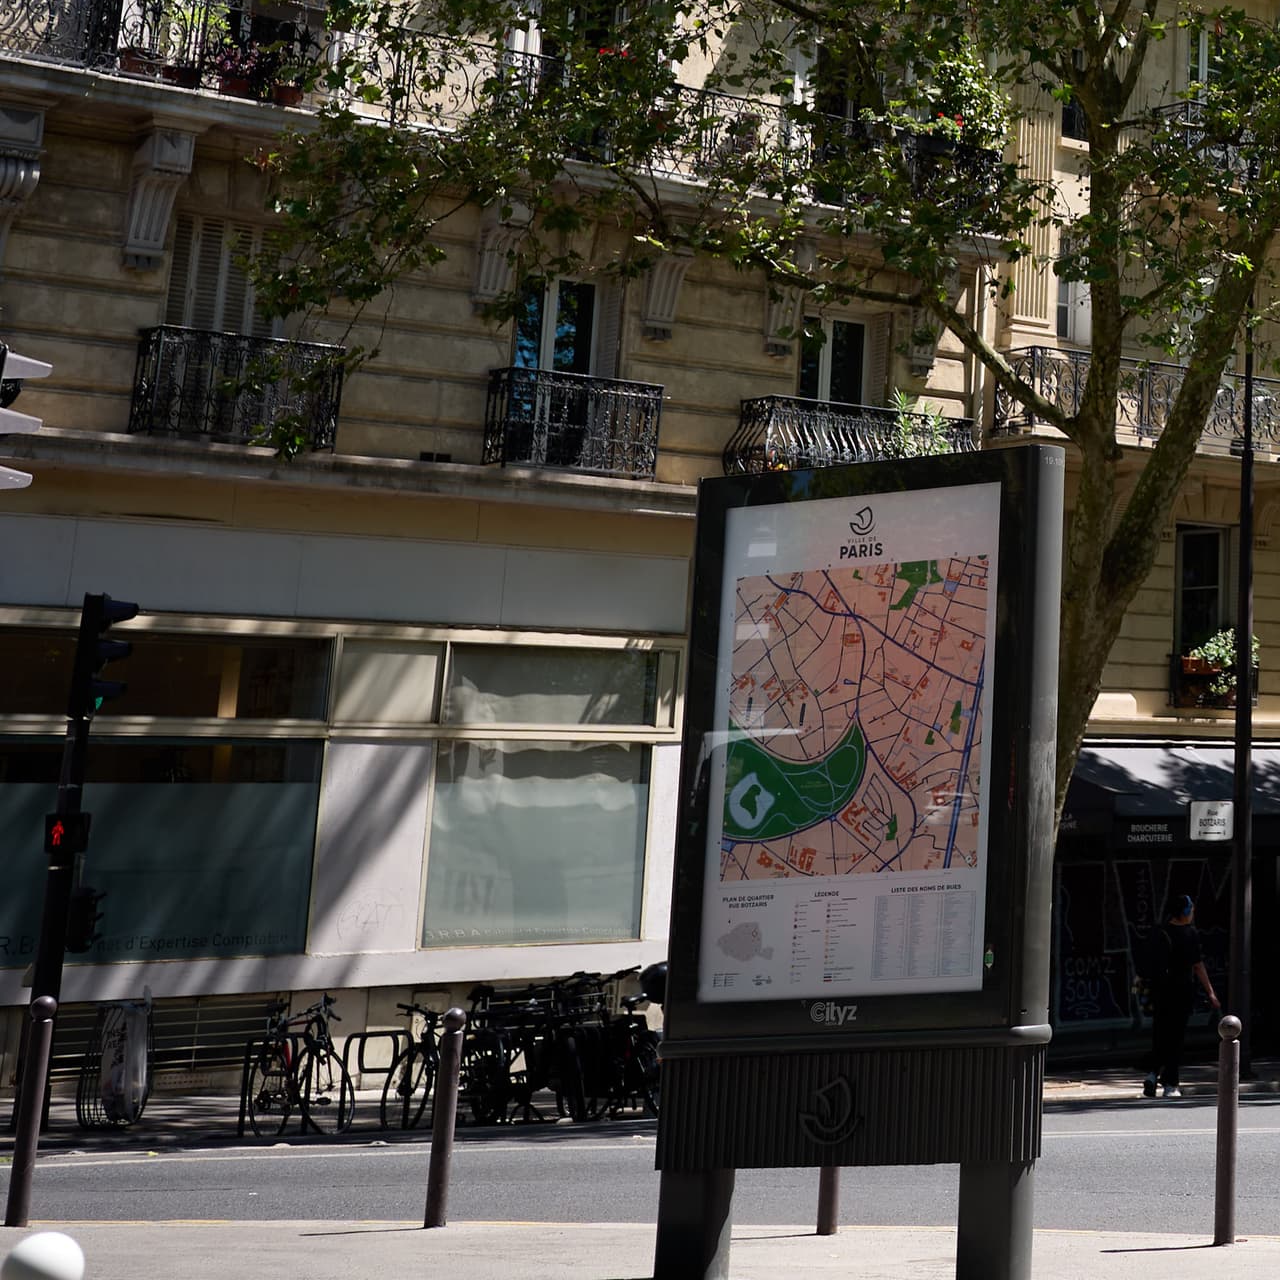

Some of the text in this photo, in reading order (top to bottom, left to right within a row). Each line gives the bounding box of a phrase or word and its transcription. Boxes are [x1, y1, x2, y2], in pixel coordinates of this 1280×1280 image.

[840, 542, 883, 560] PARIS
[1131, 824, 1168, 832] BOUCHERIE
[1128, 834, 1173, 842] CHARCUTERIE
[125, 934, 208, 953] d'Expertise
[810, 1001, 857, 1025] Cityz
